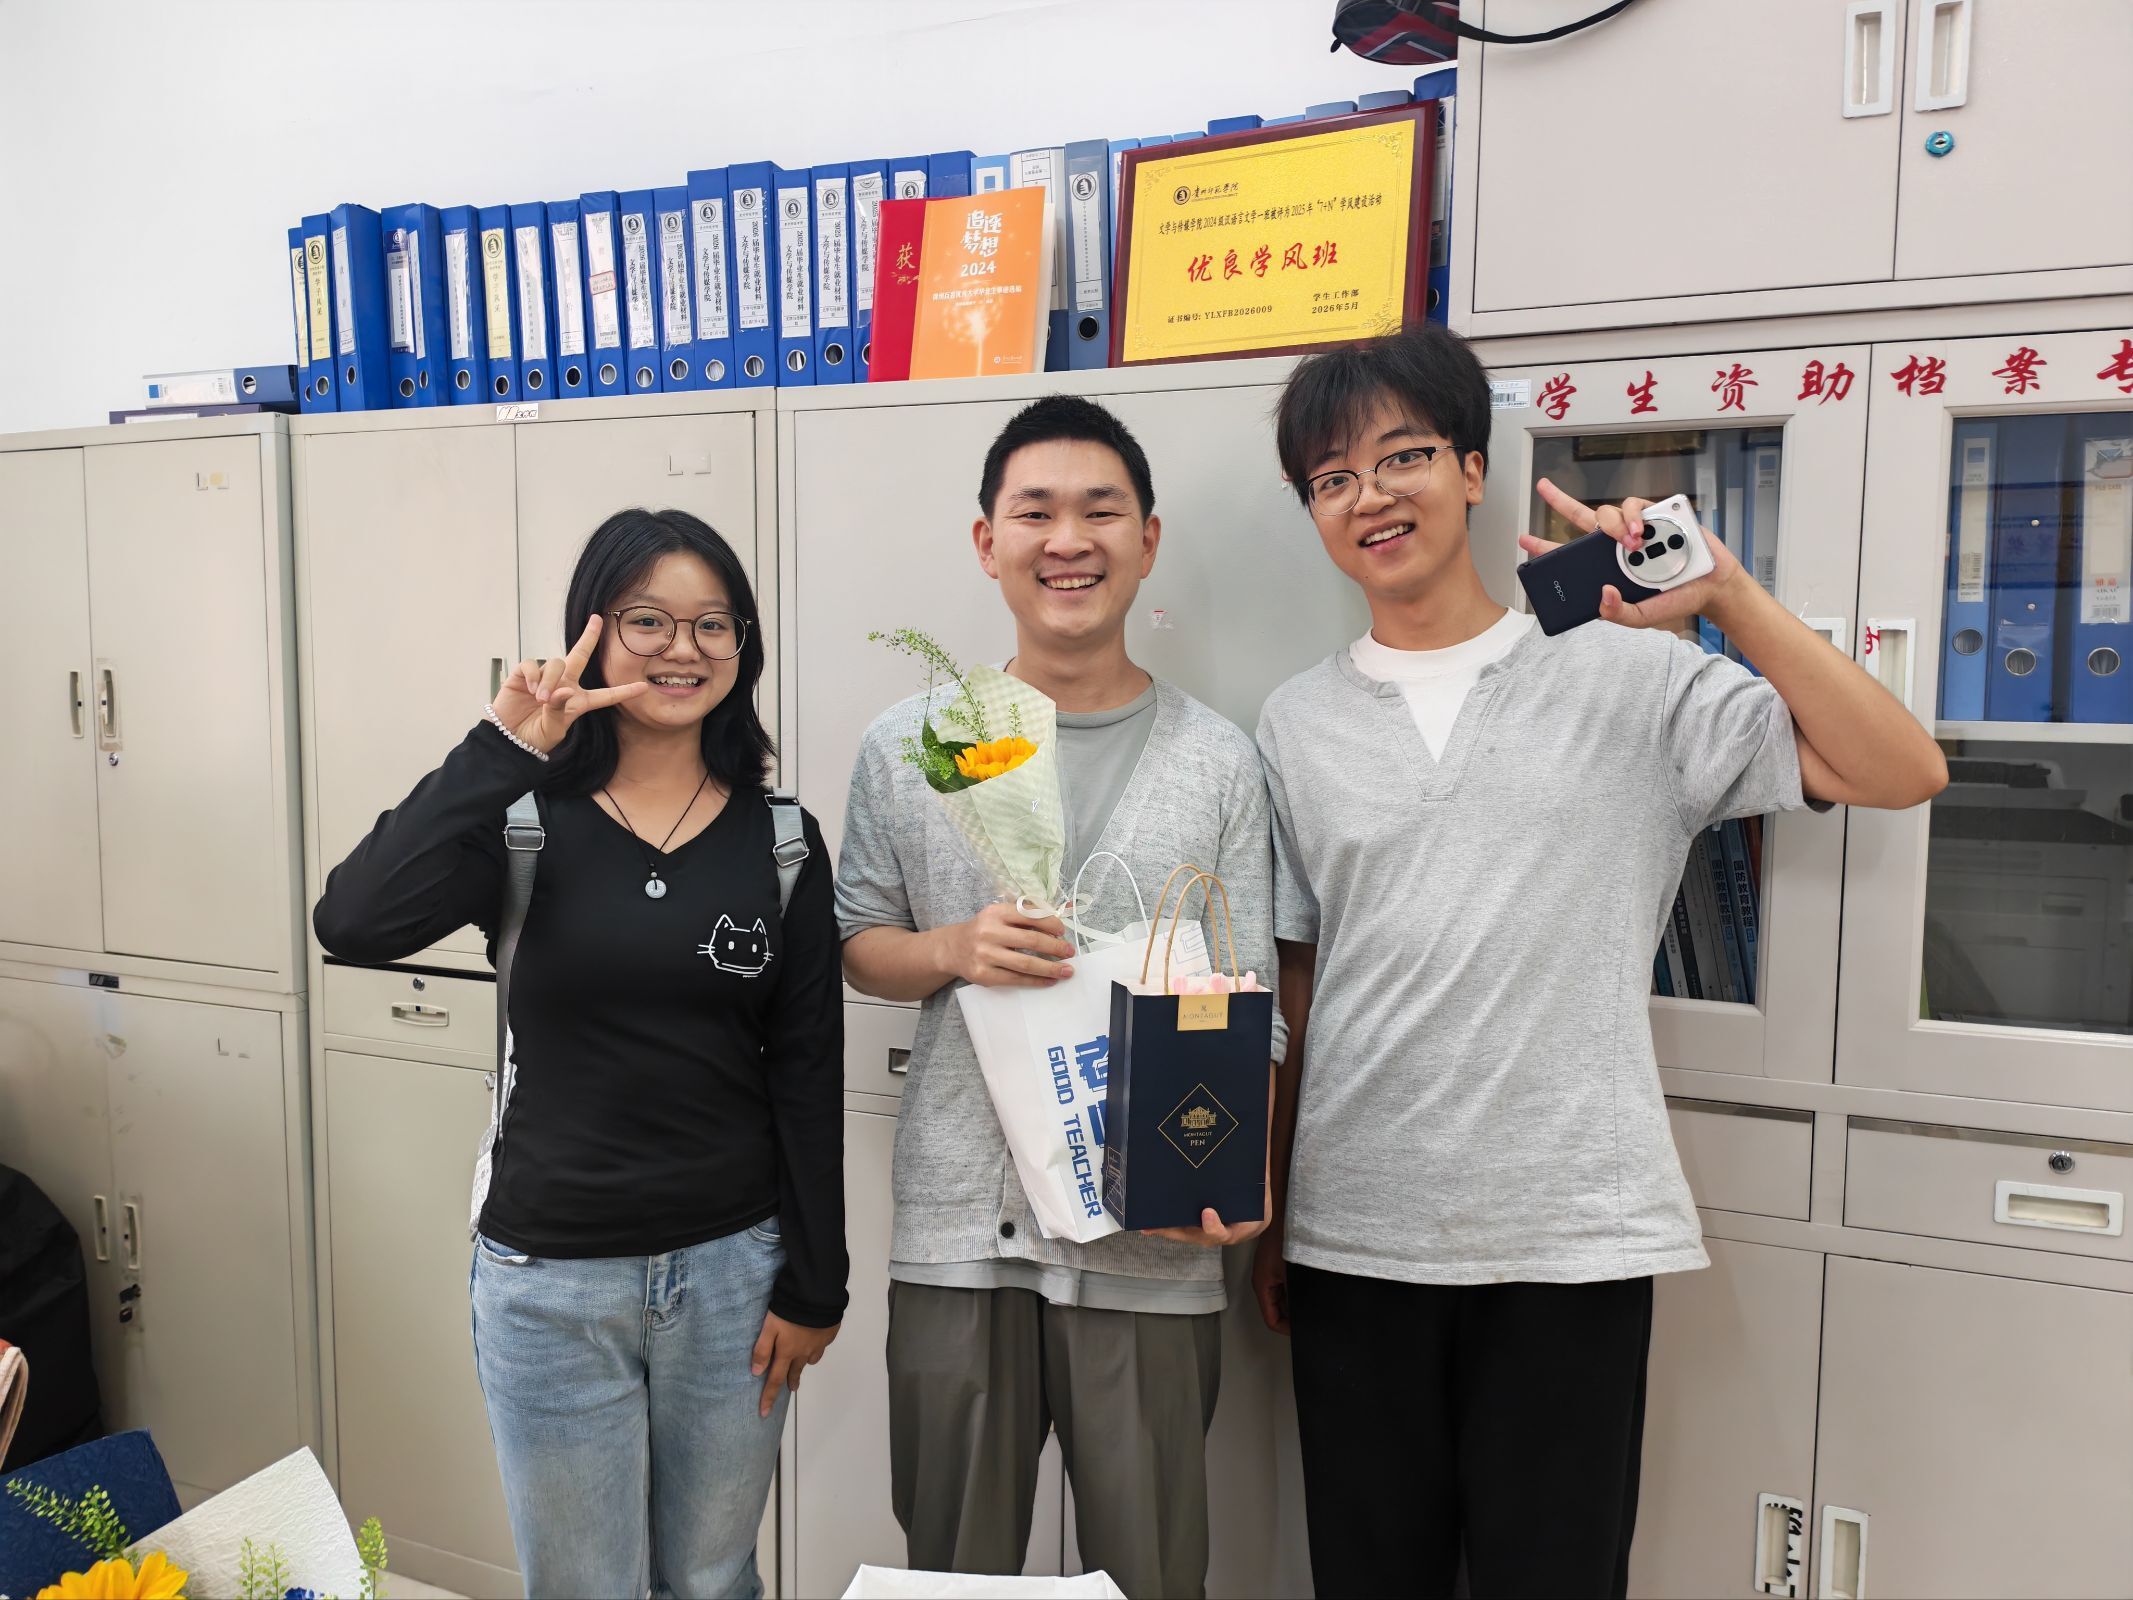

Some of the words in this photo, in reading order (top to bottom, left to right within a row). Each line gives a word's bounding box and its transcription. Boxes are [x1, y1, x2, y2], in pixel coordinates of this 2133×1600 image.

[966, 209, 1004, 234] 追逐
[960, 231, 999, 258] 梦想
[960, 262, 997, 277] 2024
[1186, 240, 1339, 283] 优良学风班
[1312, 288, 1360, 302] 学生工作部
[1204, 305, 1274, 320] YLXFB2026009
[1311, 302, 1359, 314] 2026年5月
[1711, 859, 1733, 926] 国防教育教程
[1732, 860, 1755, 928] 国防教育教程
[1047, 1045, 1075, 1106] GOOD
[1063, 1112, 1103, 1219] TEACHER
[1190, 1139, 1206, 1147] PEN
